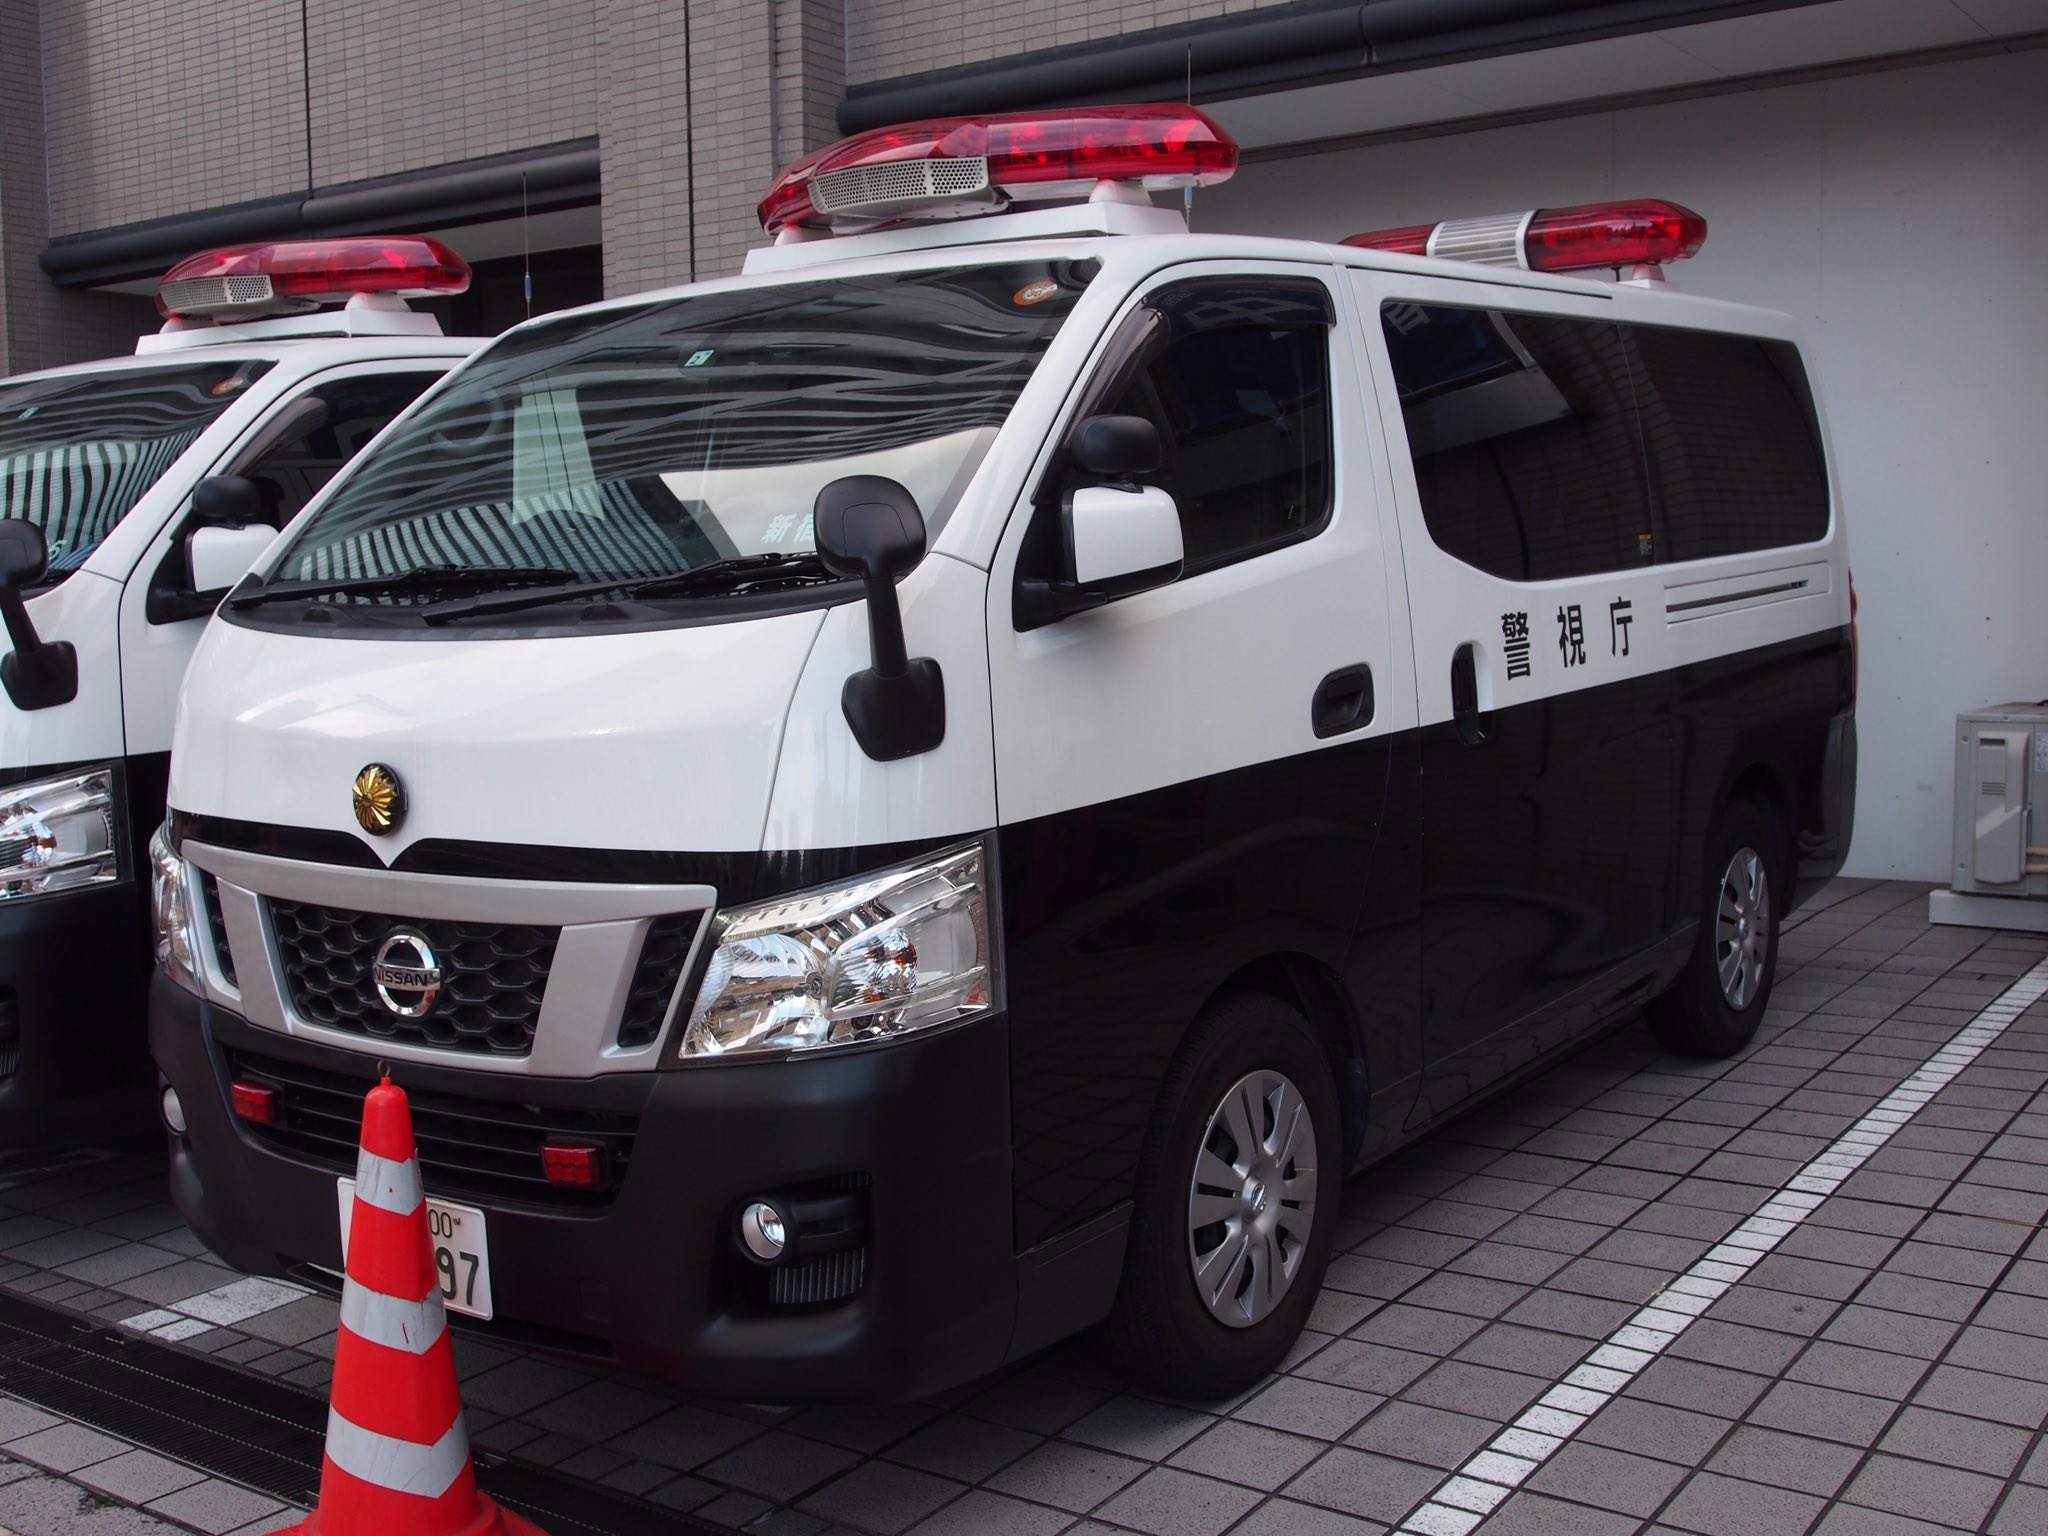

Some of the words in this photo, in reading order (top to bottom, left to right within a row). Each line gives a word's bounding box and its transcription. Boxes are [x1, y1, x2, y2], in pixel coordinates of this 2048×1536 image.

[1501, 596, 1633, 680] 警視庁
[373, 968, 428, 986] NISSAN
